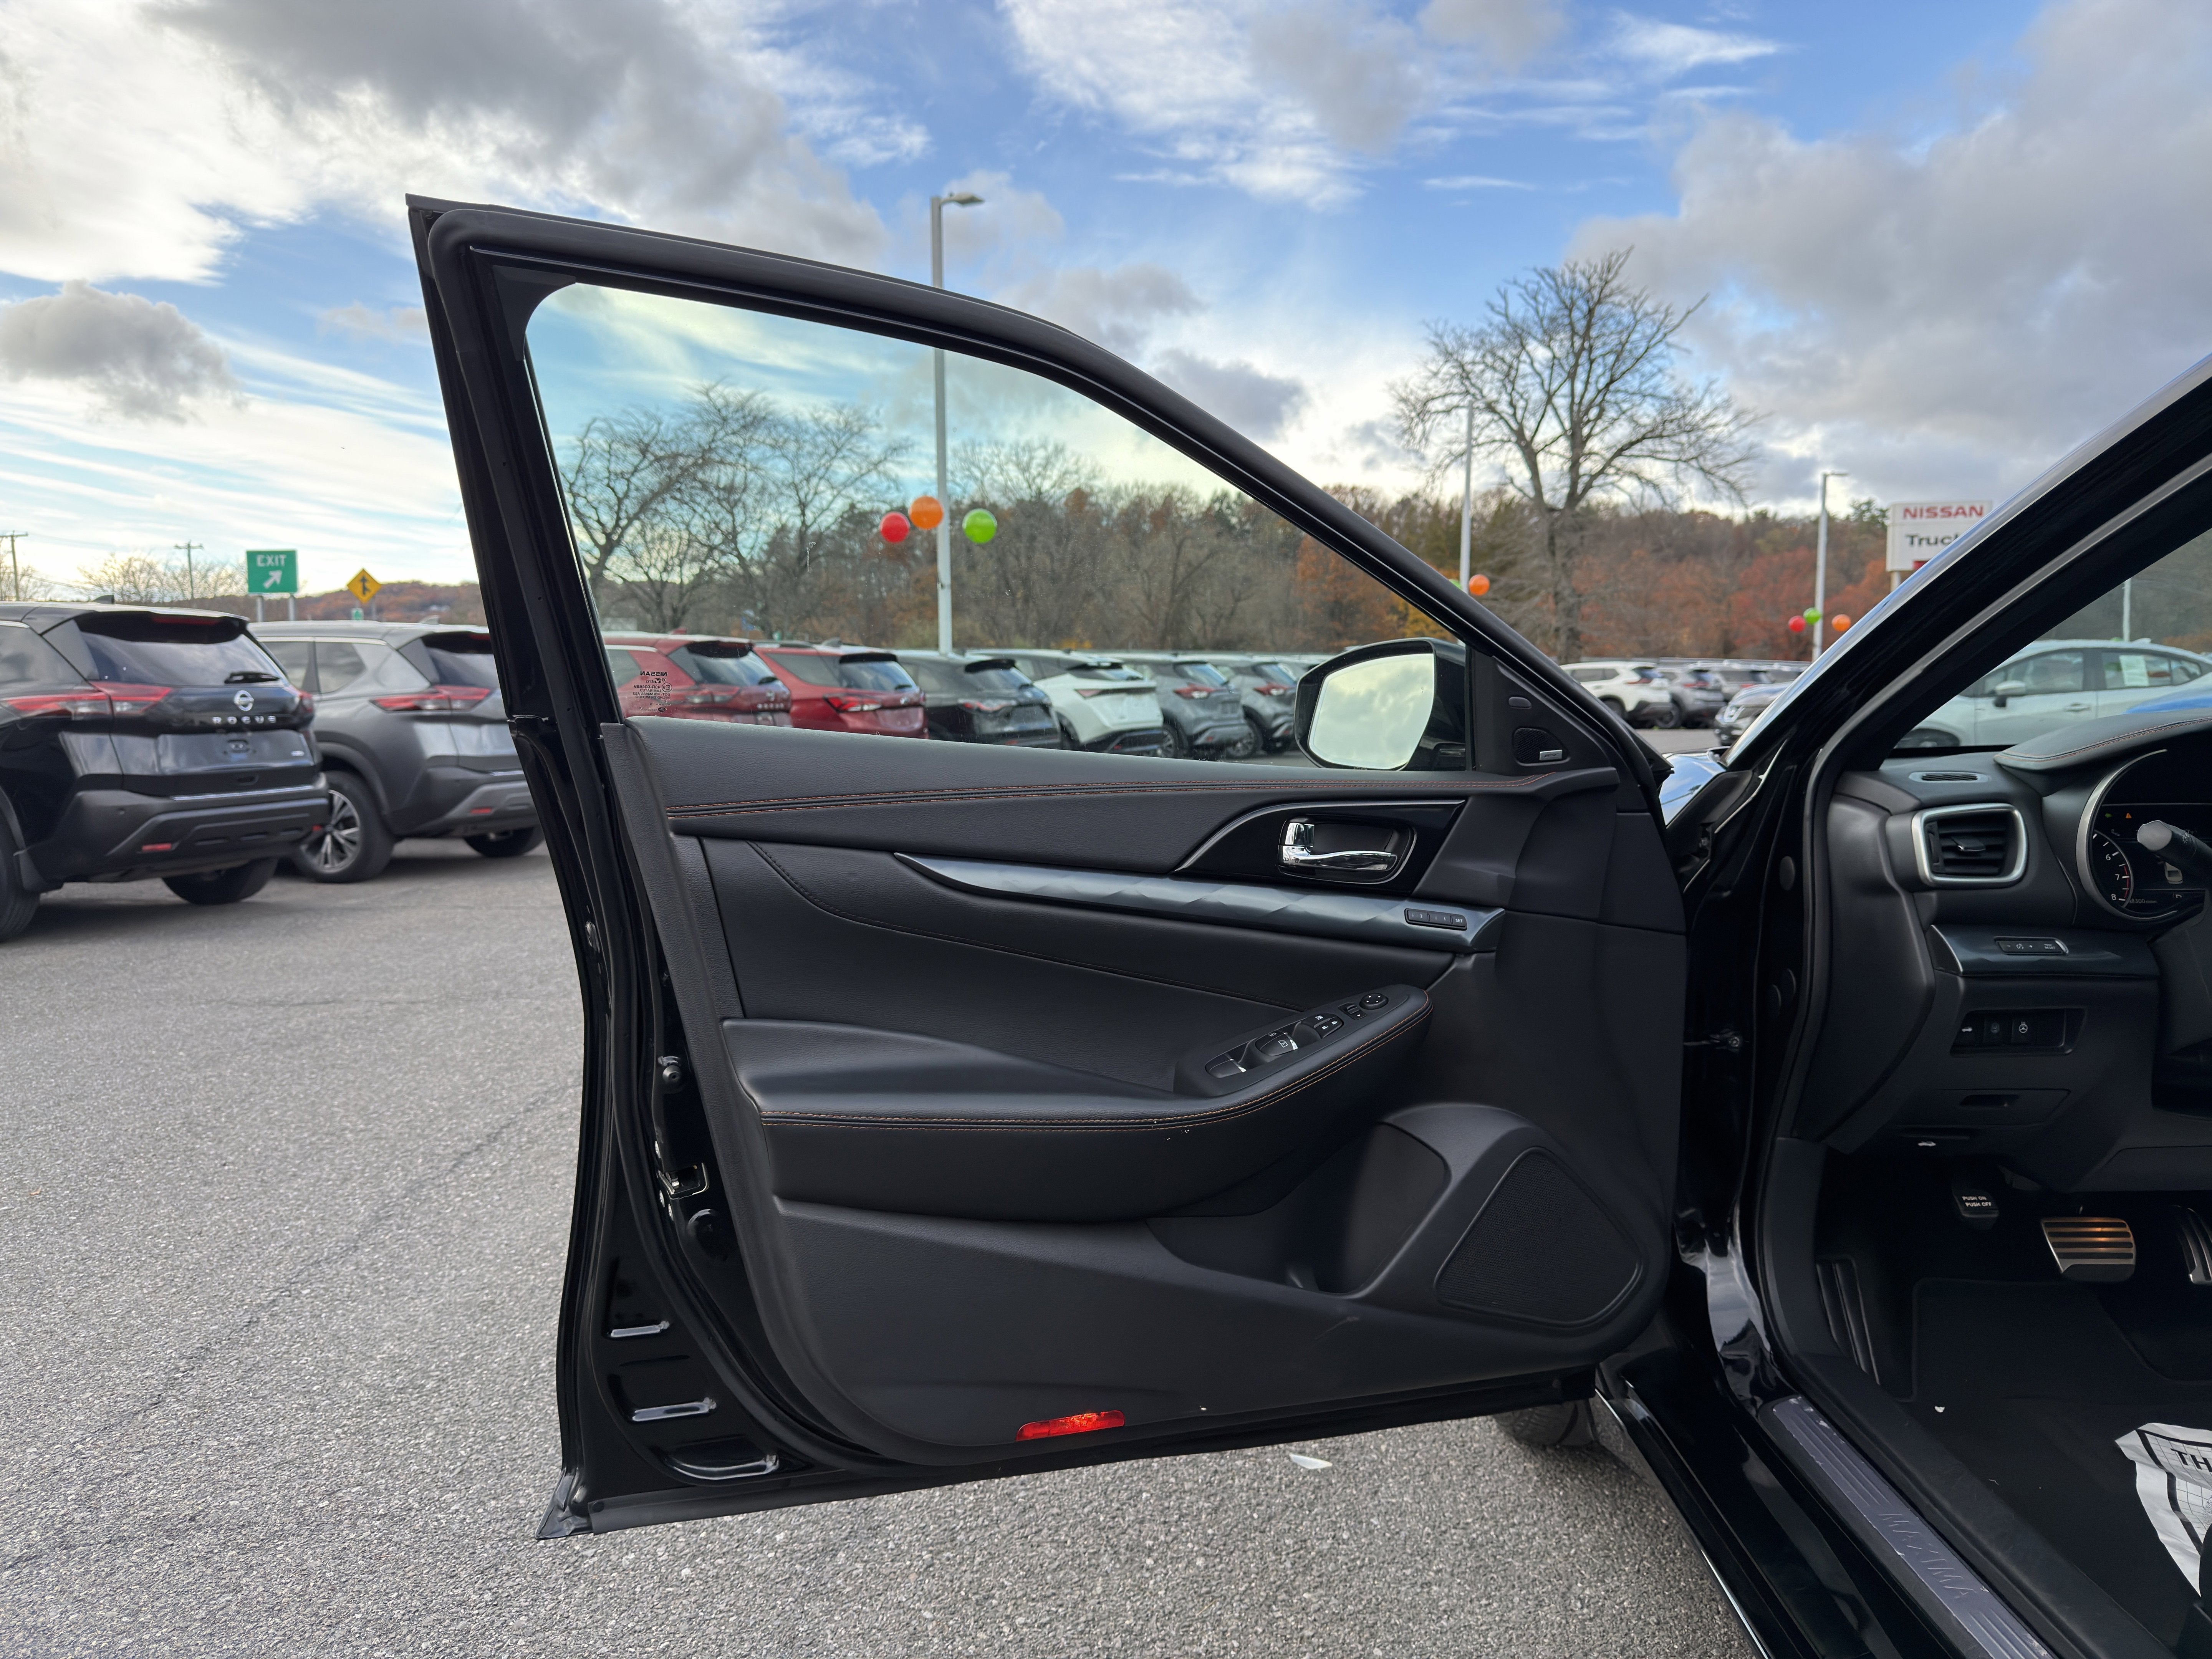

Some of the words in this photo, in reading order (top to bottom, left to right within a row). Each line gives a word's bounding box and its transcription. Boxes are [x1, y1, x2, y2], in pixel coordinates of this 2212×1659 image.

[1903, 505, 1984, 519] NISSAN
[1906, 533, 1959, 546] Truc
[257, 555, 286, 567] EXIT
